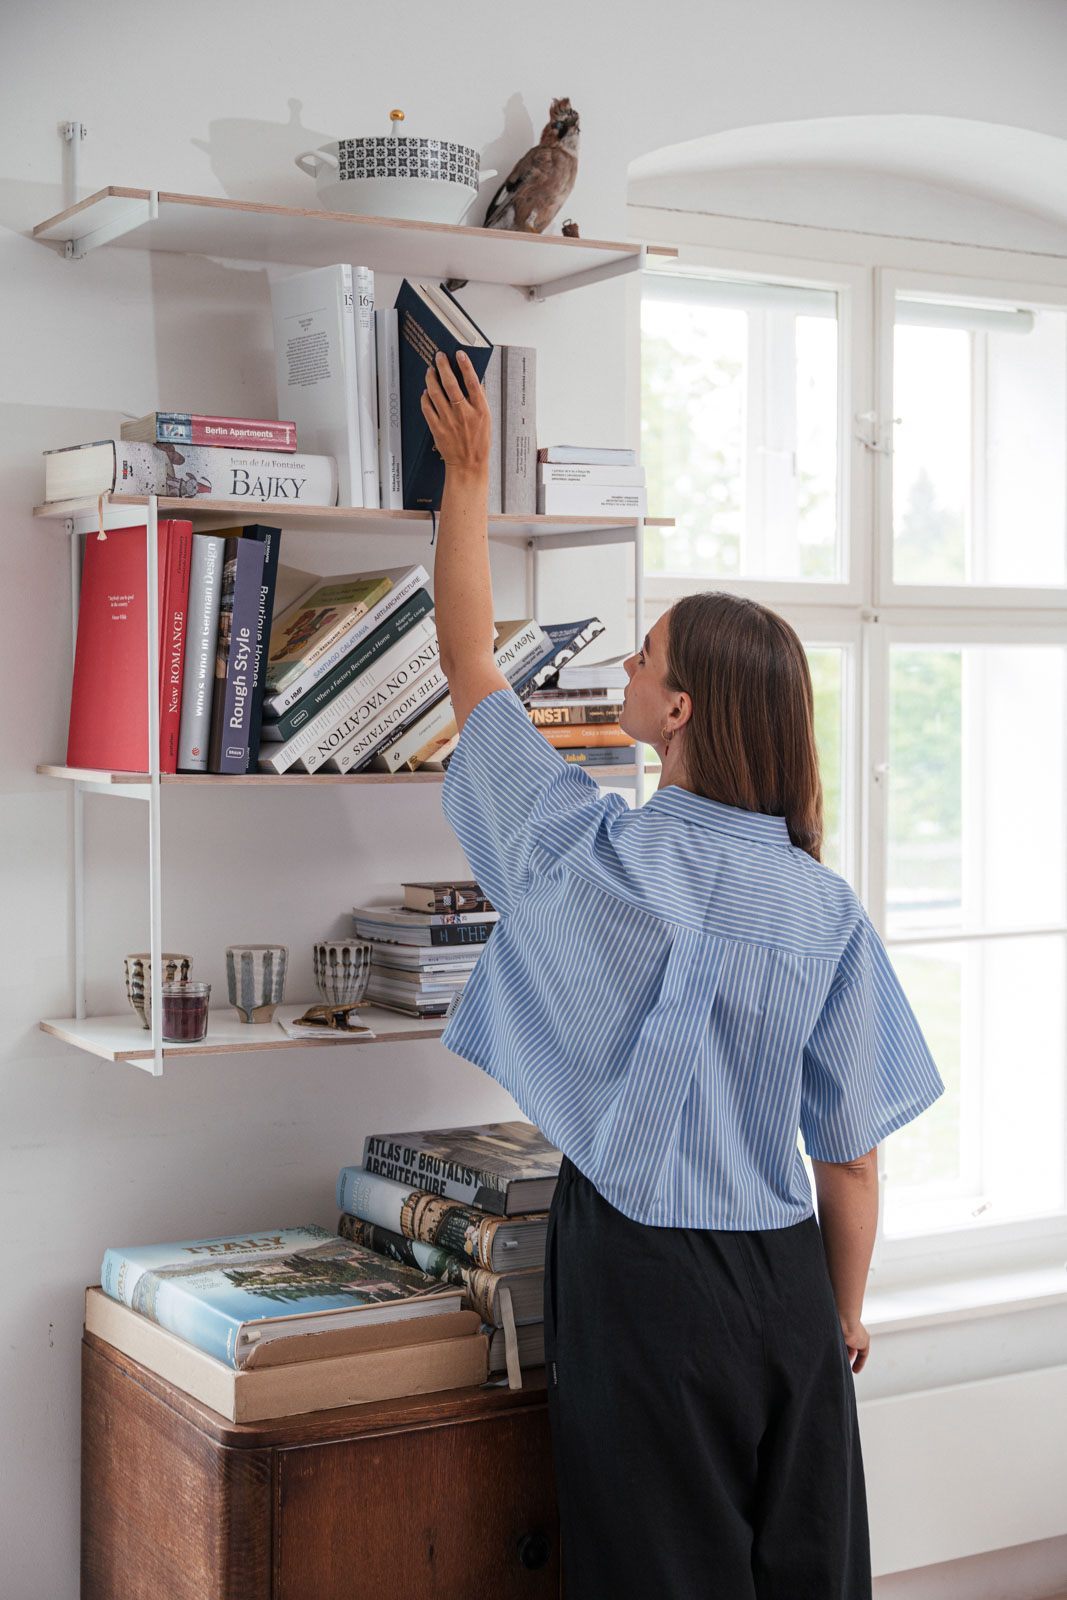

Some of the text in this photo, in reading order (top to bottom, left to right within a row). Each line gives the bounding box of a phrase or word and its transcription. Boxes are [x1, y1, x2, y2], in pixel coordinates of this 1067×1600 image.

[344, 295, 353, 306] 15
[359, 295, 368, 306] 16
[390, 392, 400, 428] 20000
[205, 426, 273, 438] Berlin Apartments
[230, 458, 248, 466] Jean
[250, 458, 259, 467] de
[272, 460, 306, 470] Fontaine
[229, 468, 308, 502] BAJKY
[206, 542, 217, 585] Design
[204, 588, 213, 636] German
[395, 612, 411, 627] Adaptive
[413, 607, 425, 618] Living
[313, 625, 369, 678] SANTIAGO CALATRAVA
[514, 630, 536, 652] New
[169, 612, 183, 713] New ROMANCE
[315, 688, 330, 703] When
[333, 670, 352, 687] Factory
[351, 651, 372, 671] Becomes
[375, 634, 390, 648] Home
[496, 649, 515, 668] Nor
[230, 628, 250, 728] Rough Style
[387, 671, 408, 694] ON
[418, 674, 442, 698] THE
[290, 686, 302, 700] HMP
[318, 692, 388, 758] VACATION
[352, 696, 416, 756] MOUNTAINS
[457, 926, 488, 942] THE
[368, 1138, 480, 1188] ATLAS OF BRUTALIST
[366, 1156, 447, 1196] ARCHITECTURE
[181, 1236, 286, 1254] ITALY
